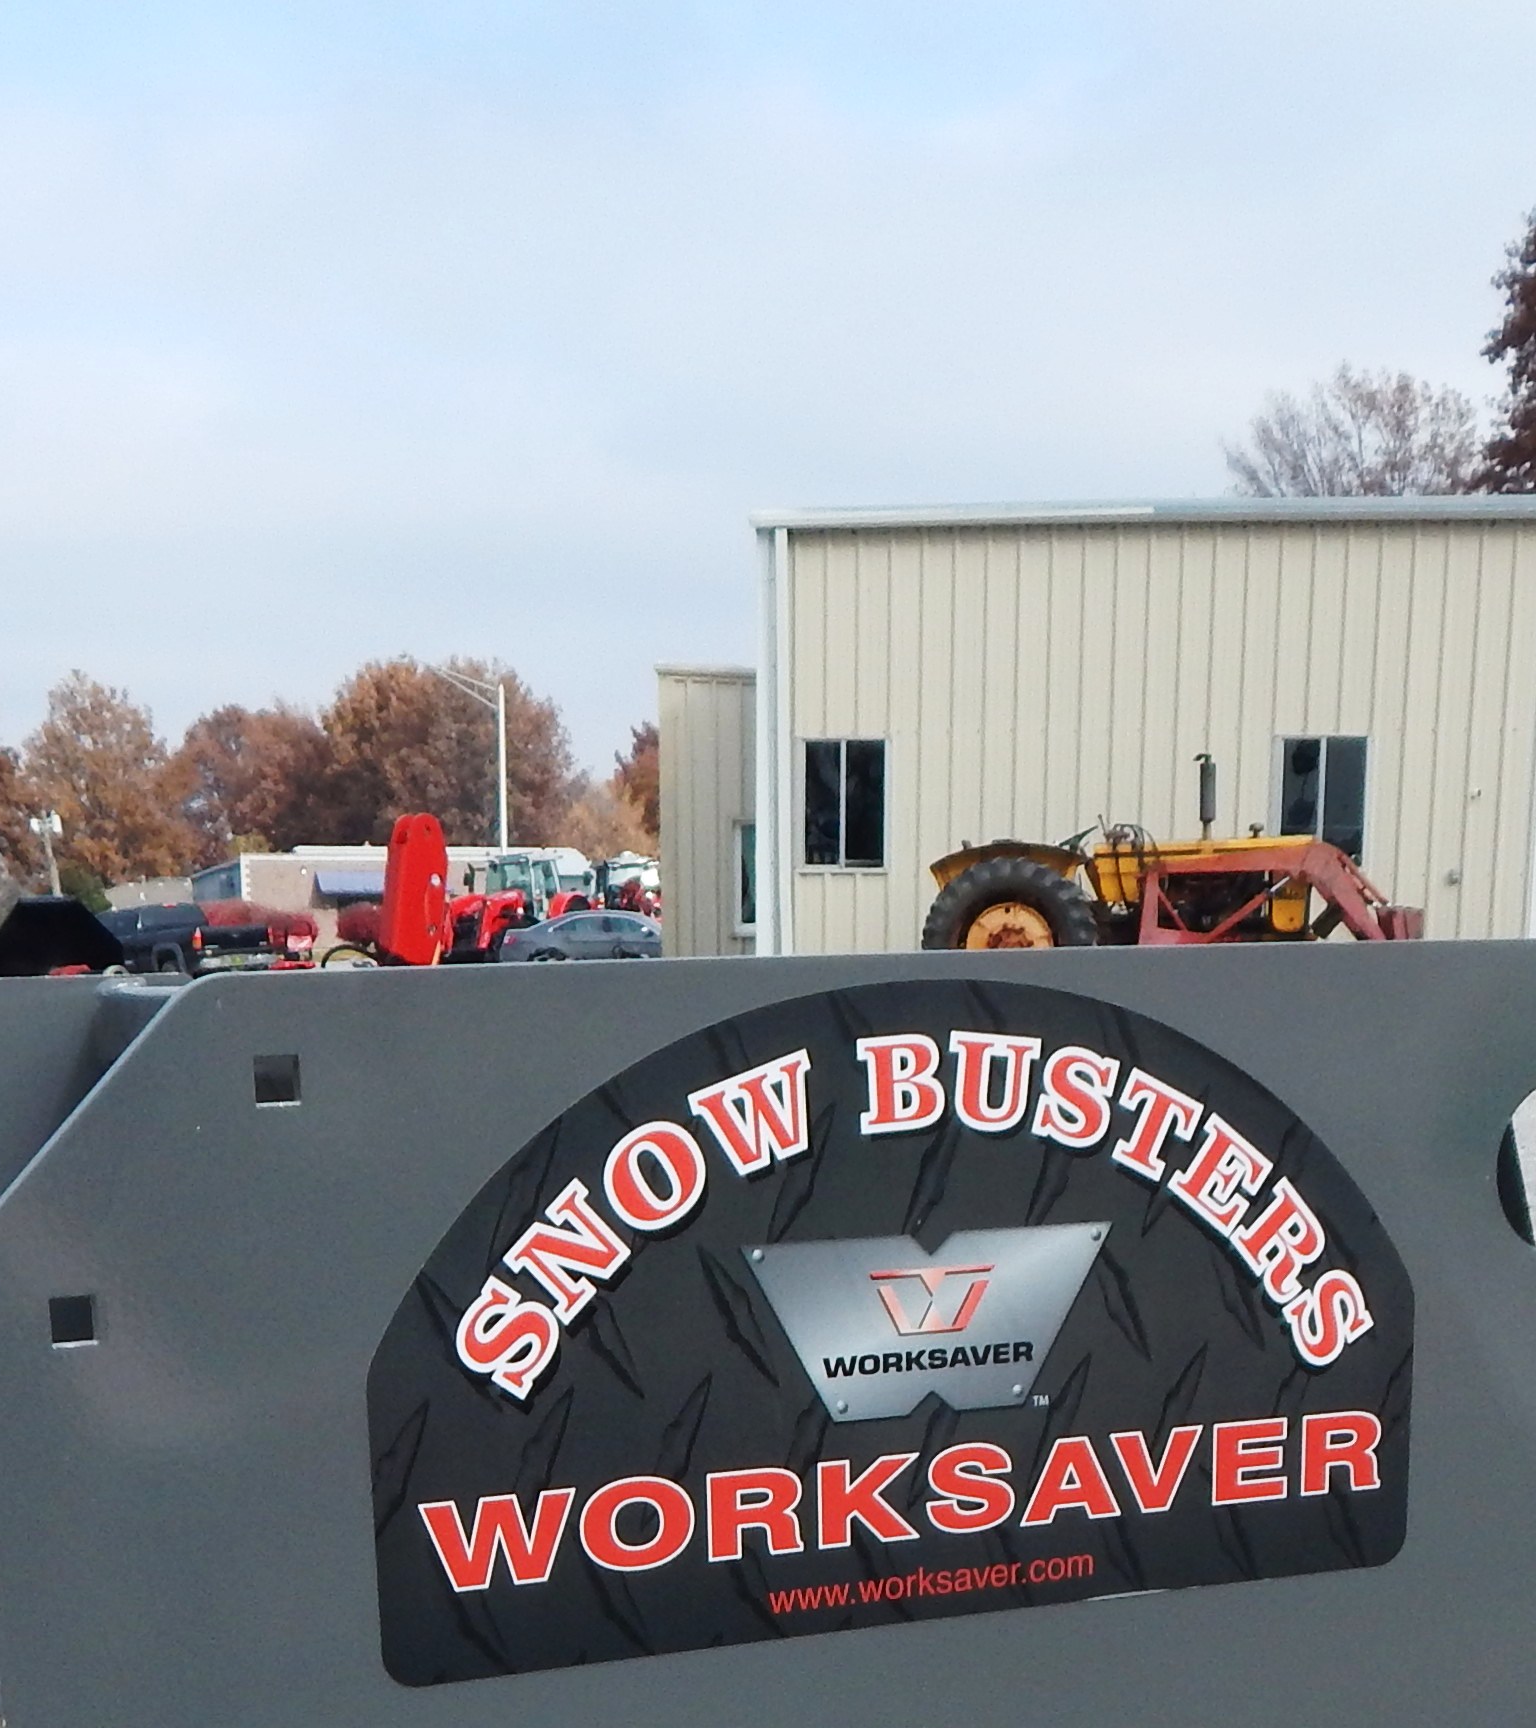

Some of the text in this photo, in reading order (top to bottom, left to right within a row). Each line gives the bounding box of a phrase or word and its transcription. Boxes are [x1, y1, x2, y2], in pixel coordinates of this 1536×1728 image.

[456, 1030, 1374, 1400] SNOW BUSTERS
[823, 1341, 1034, 1379] WORKSAVER
[418, 1410, 1382, 1593] WORKSAVER
[769, 1553, 1094, 1614] www.worksaver.com
